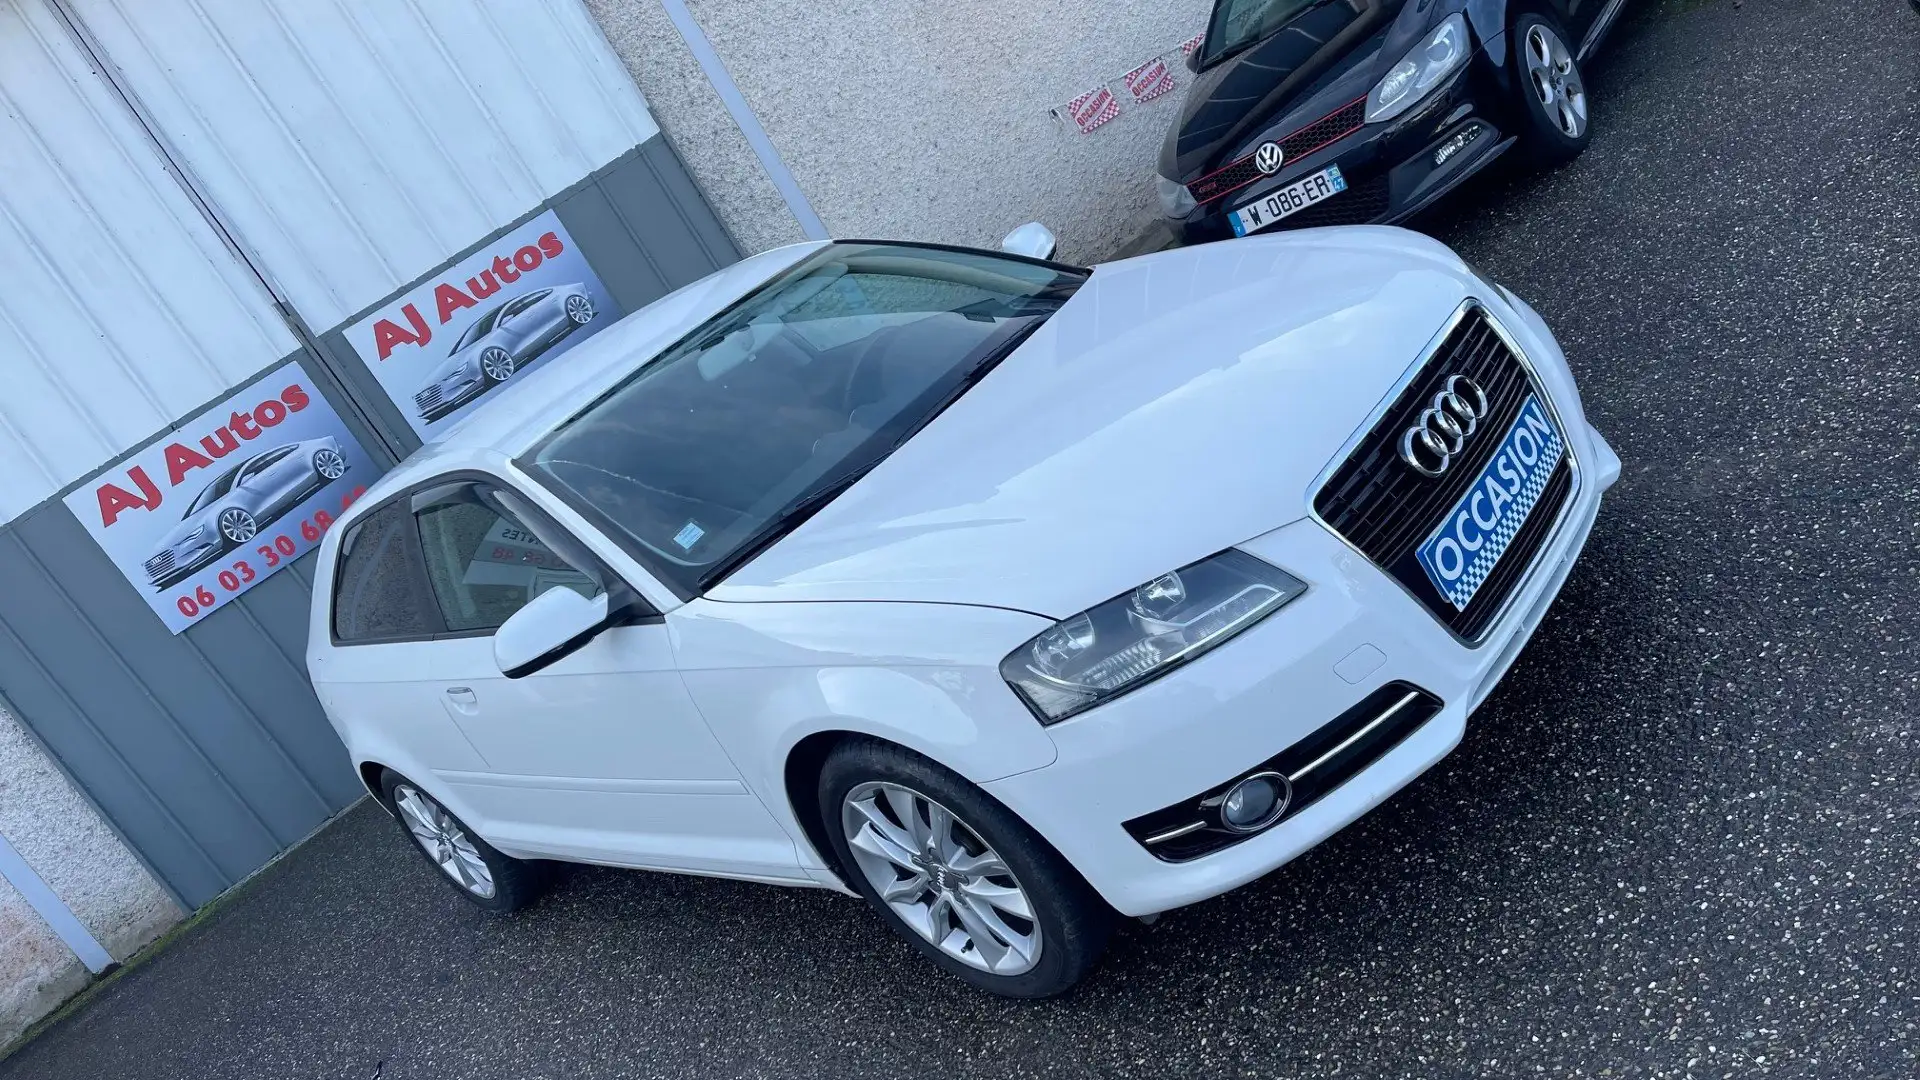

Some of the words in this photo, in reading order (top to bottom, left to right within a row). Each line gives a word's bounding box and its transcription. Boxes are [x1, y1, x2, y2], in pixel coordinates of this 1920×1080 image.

[1076, 88, 1111, 127] OCCASION
[1131, 62, 1167, 97] OCCASION
[373, 302, 432, 361] AJ
[434, 231, 564, 325] Autos
[96, 465, 163, 528] AJ
[164, 384, 310, 487] Autos
[1435, 402, 1552, 581] OCCASION
[176, 585, 216, 617] 06
[218, 561, 256, 591] 03
[257, 535, 296, 568] 30
